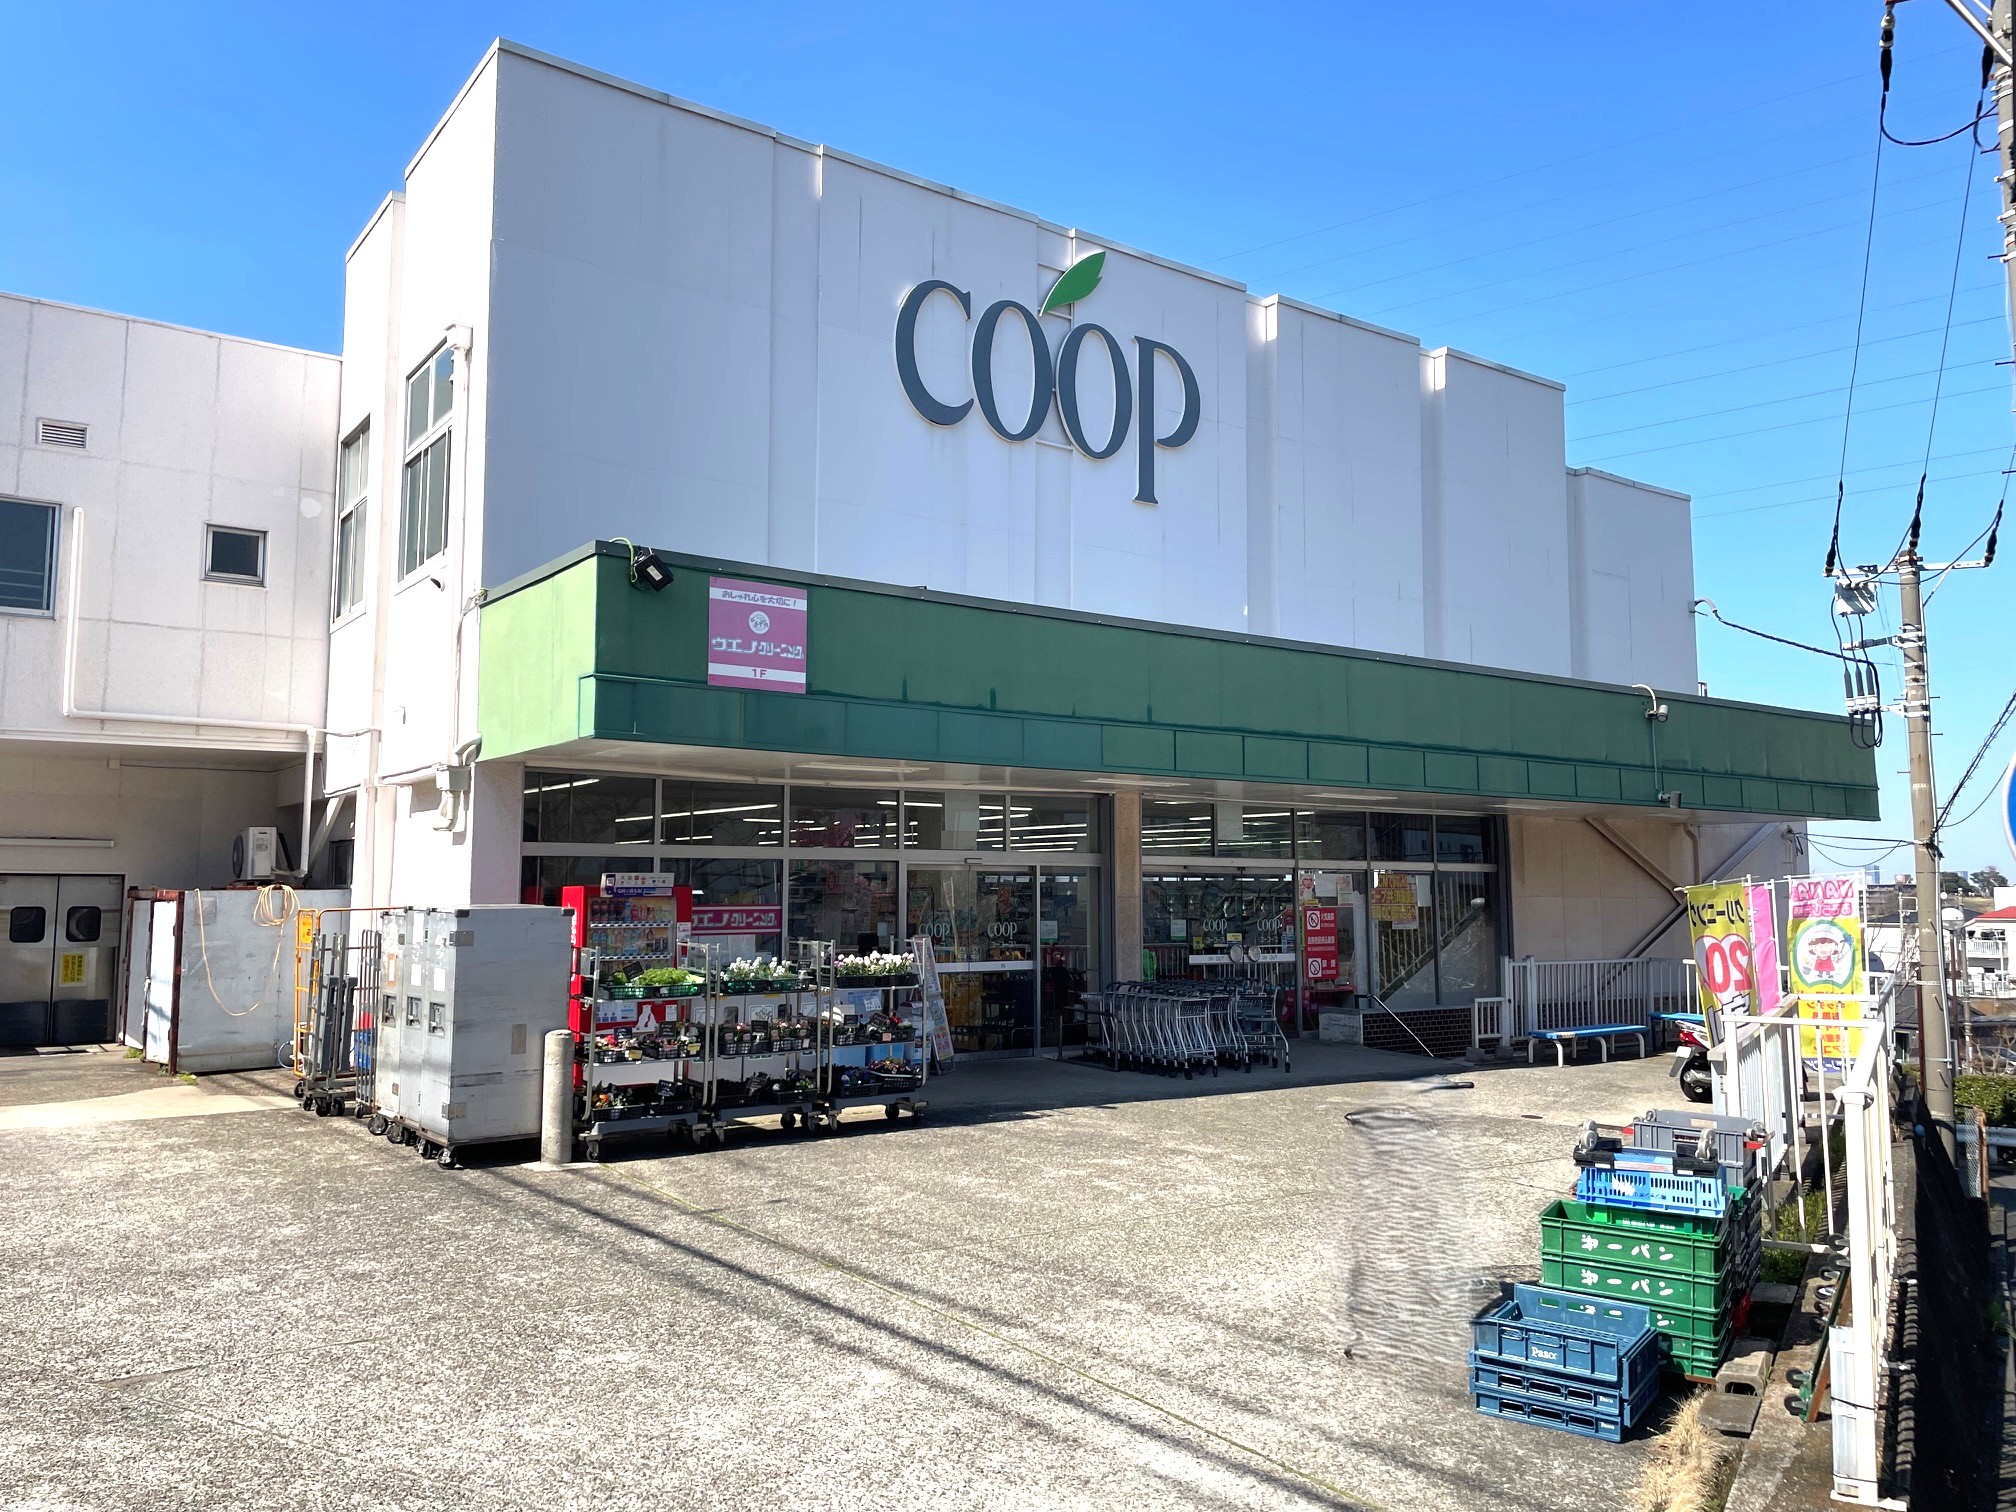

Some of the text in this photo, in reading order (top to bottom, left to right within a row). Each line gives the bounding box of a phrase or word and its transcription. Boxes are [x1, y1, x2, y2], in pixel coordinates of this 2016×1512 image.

[895, 280, 1201, 504] COOP
[988, 922, 1017, 939] COOP
[1203, 919, 1228, 934] COOP
[1257, 919, 1281, 934] COOP
